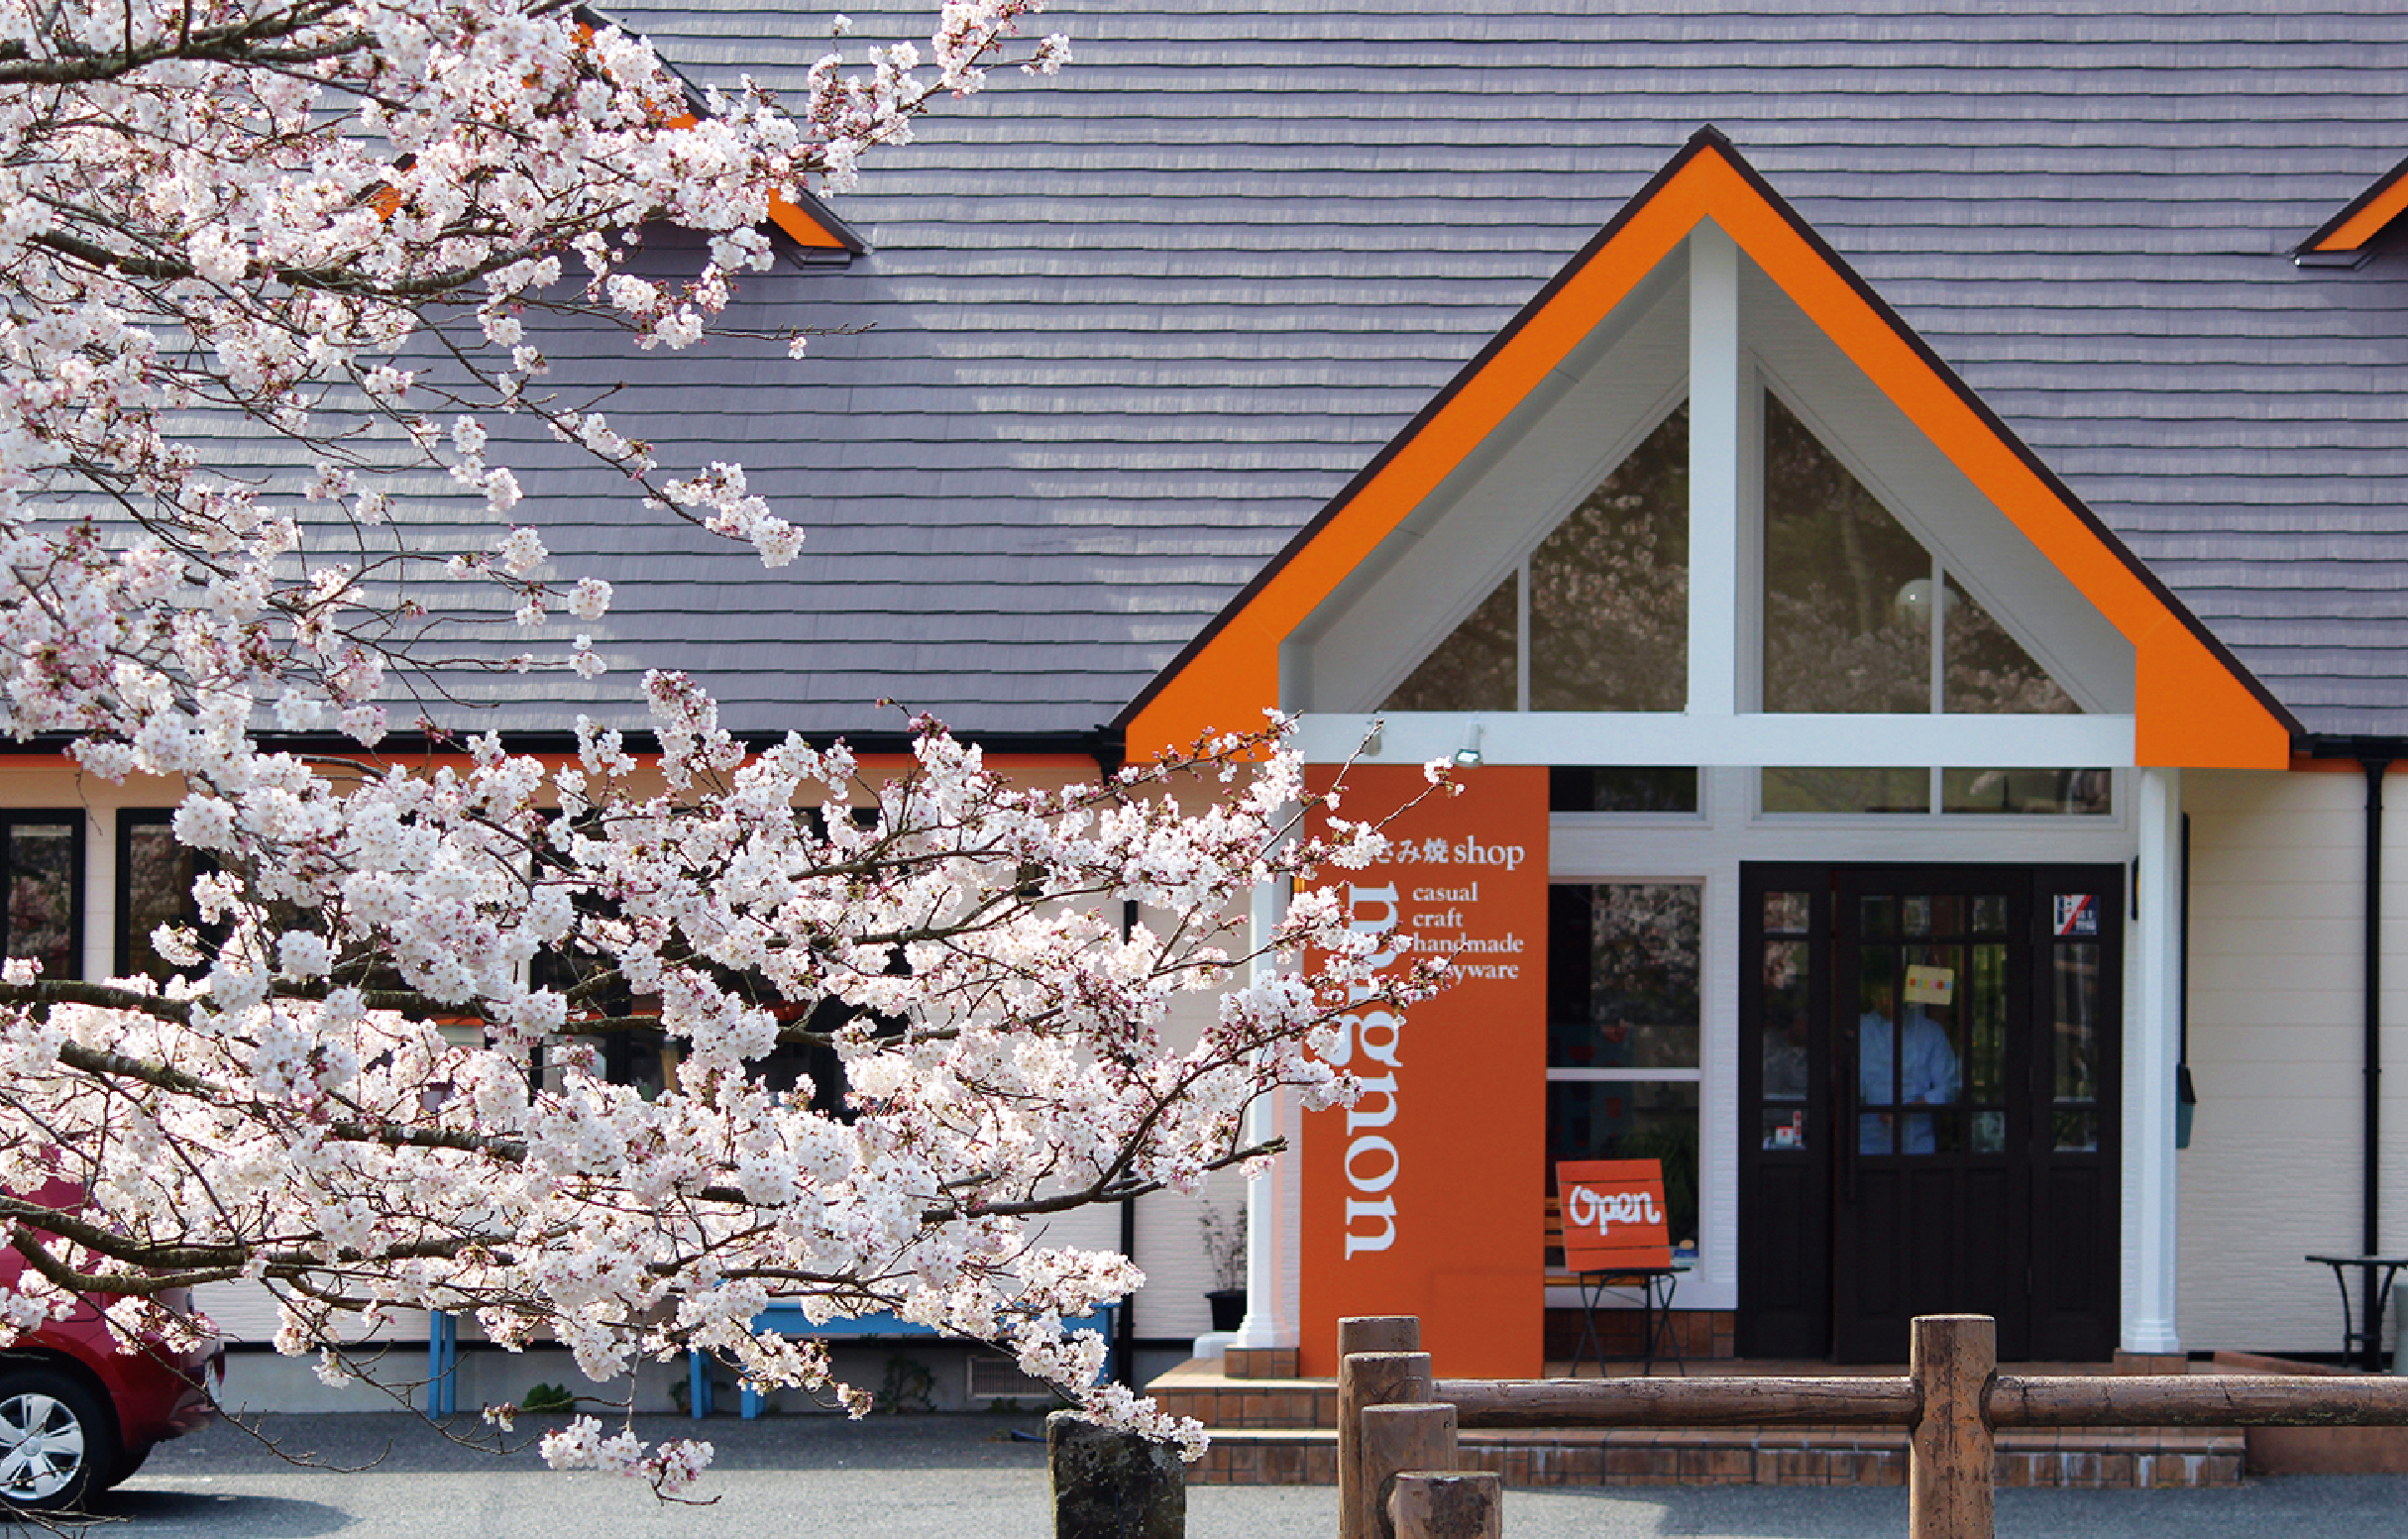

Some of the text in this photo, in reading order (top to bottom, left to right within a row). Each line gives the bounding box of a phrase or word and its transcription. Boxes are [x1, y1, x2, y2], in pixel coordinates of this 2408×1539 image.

[1370, 835, 1526, 871] さみ焼 shop
[1412, 881, 1478, 902] casual
[1412, 907, 1464, 928] craft
[1413, 933, 1525, 953] handmade
[1570, 1185, 1662, 1236] Open
